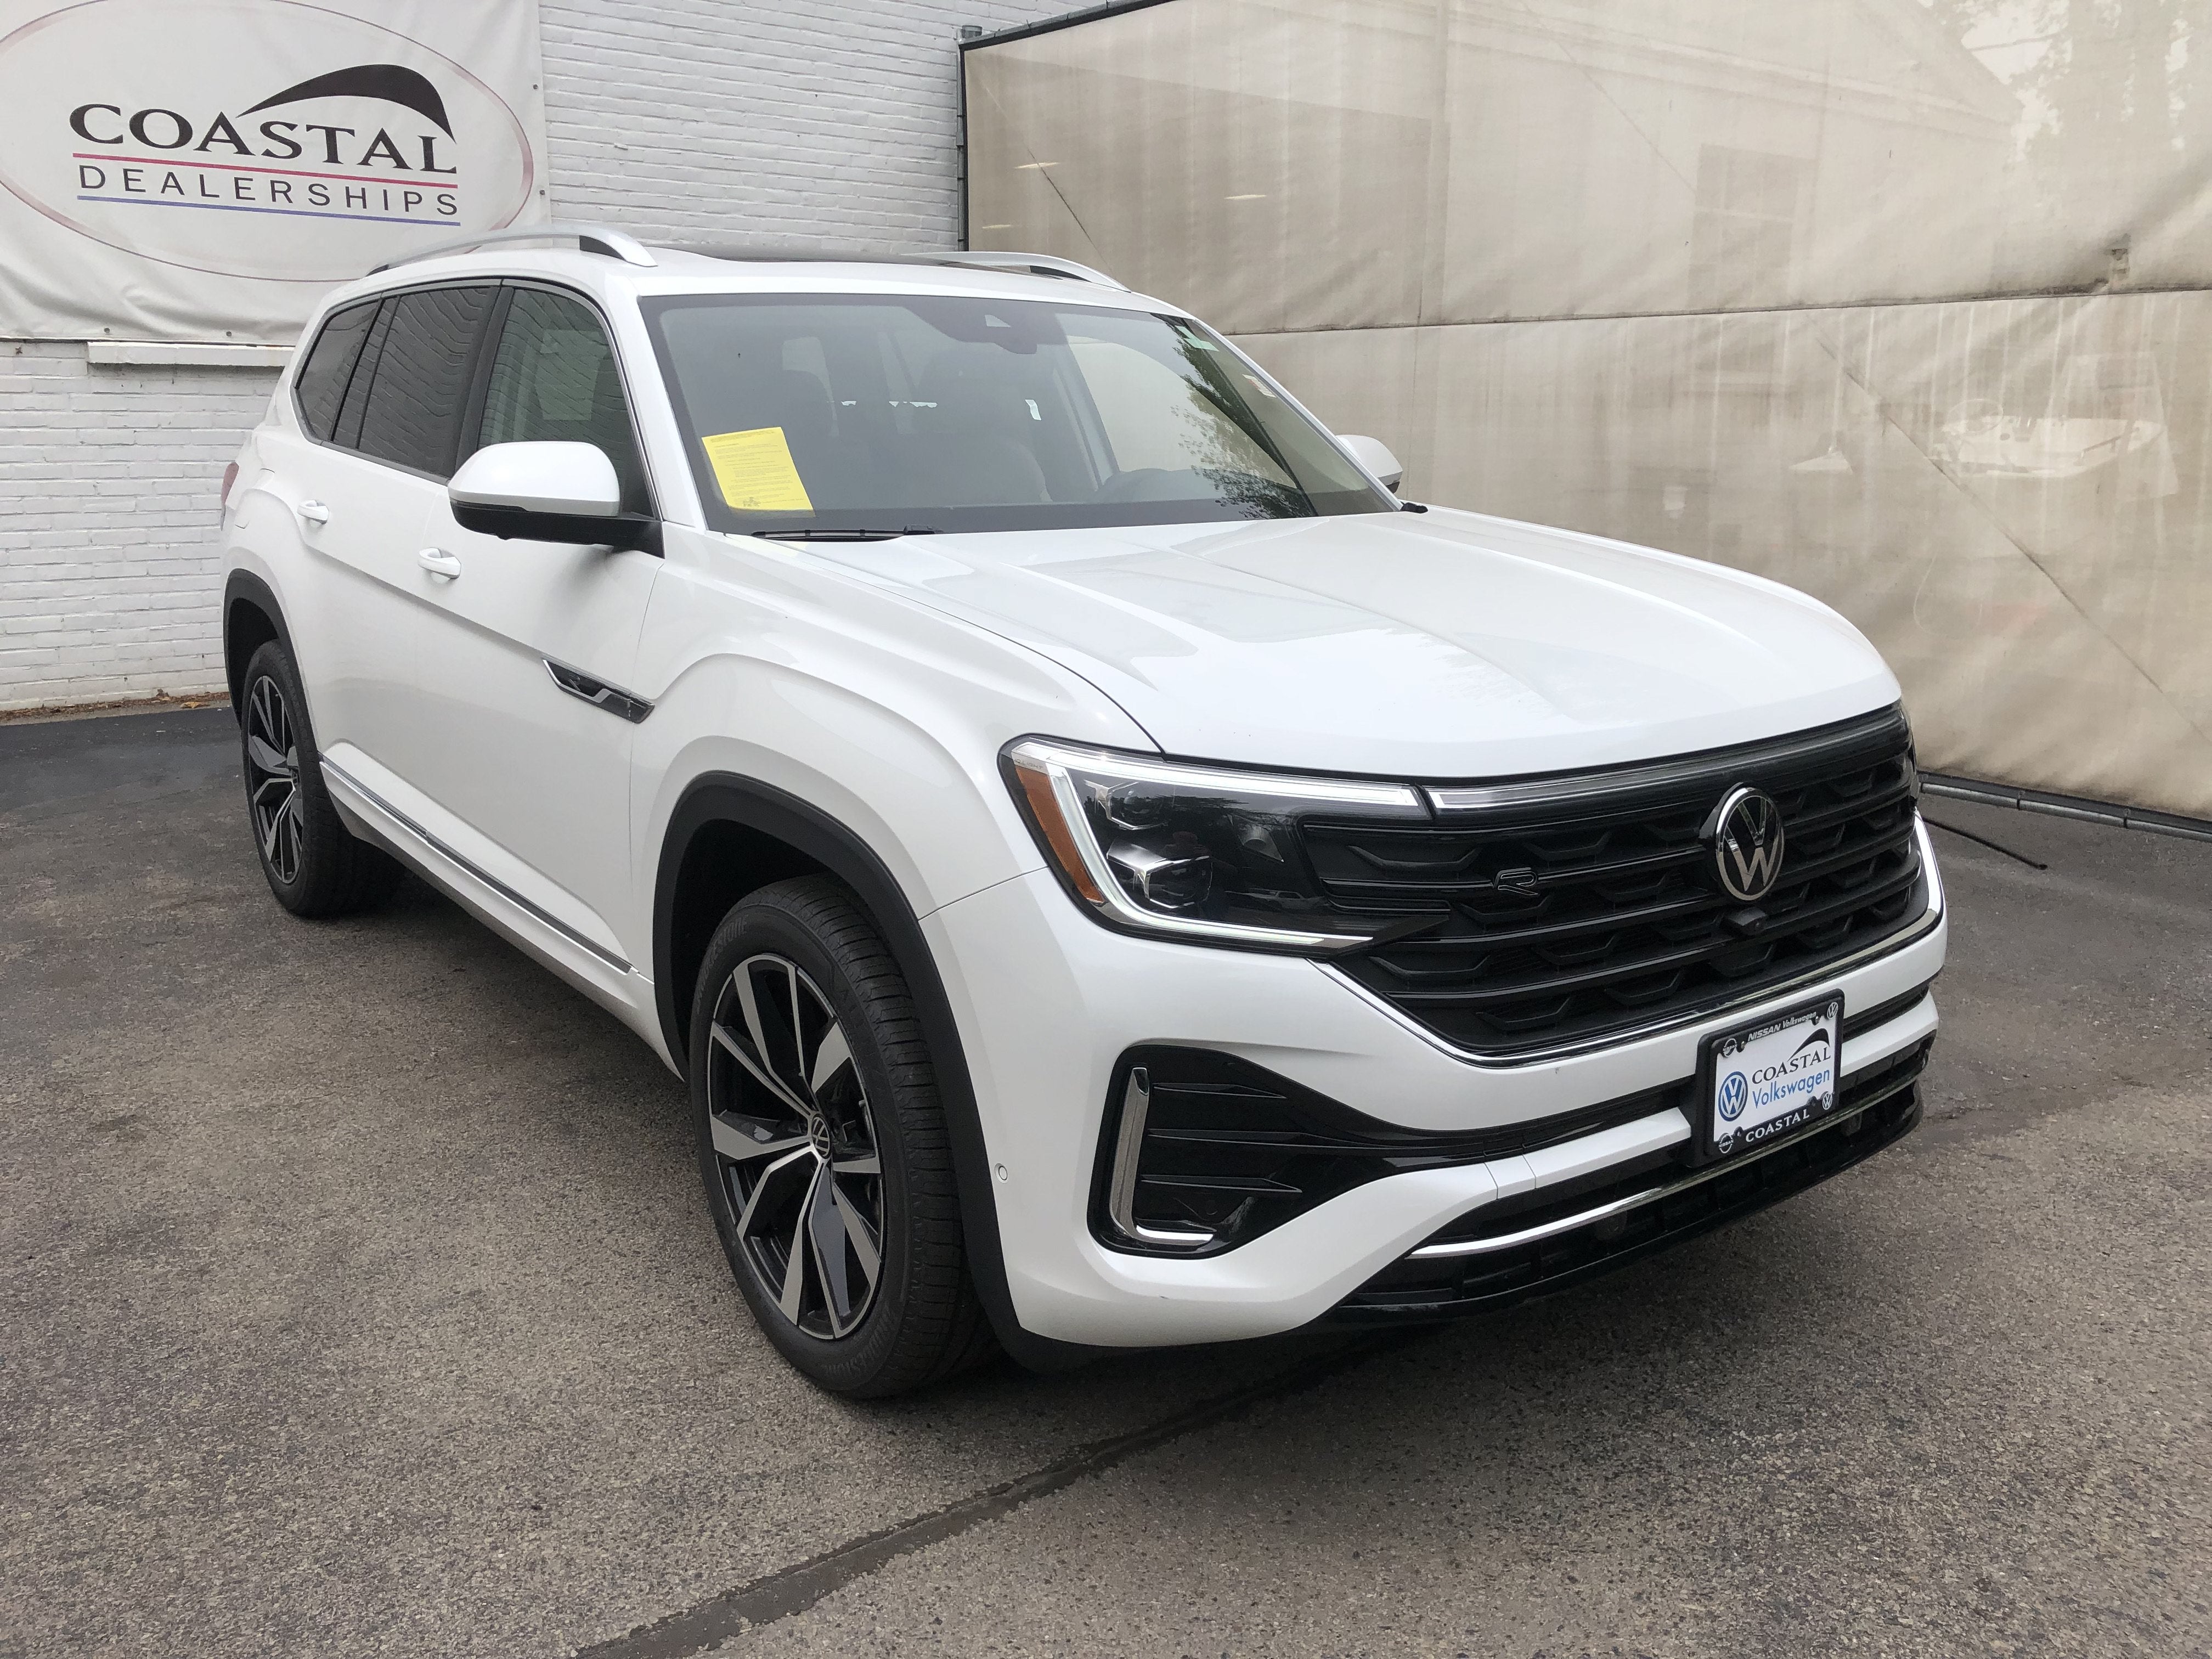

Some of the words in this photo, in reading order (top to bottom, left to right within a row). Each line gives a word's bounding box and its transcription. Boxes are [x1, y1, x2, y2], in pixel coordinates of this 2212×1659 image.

[70, 103, 458, 174] COASTAL
[79, 165, 458, 216] DEALERSHIPS
[1494, 867, 1539, 896] R
[1748, 1024, 1781, 1041] NISSAN
[1782, 1012, 1816, 1028] Volkswagen
[1752, 1047, 1831, 1084] COASTAL
[1752, 1069, 1830, 1109] Volkswagen
[1746, 1109, 1809, 1142] COASTAL
